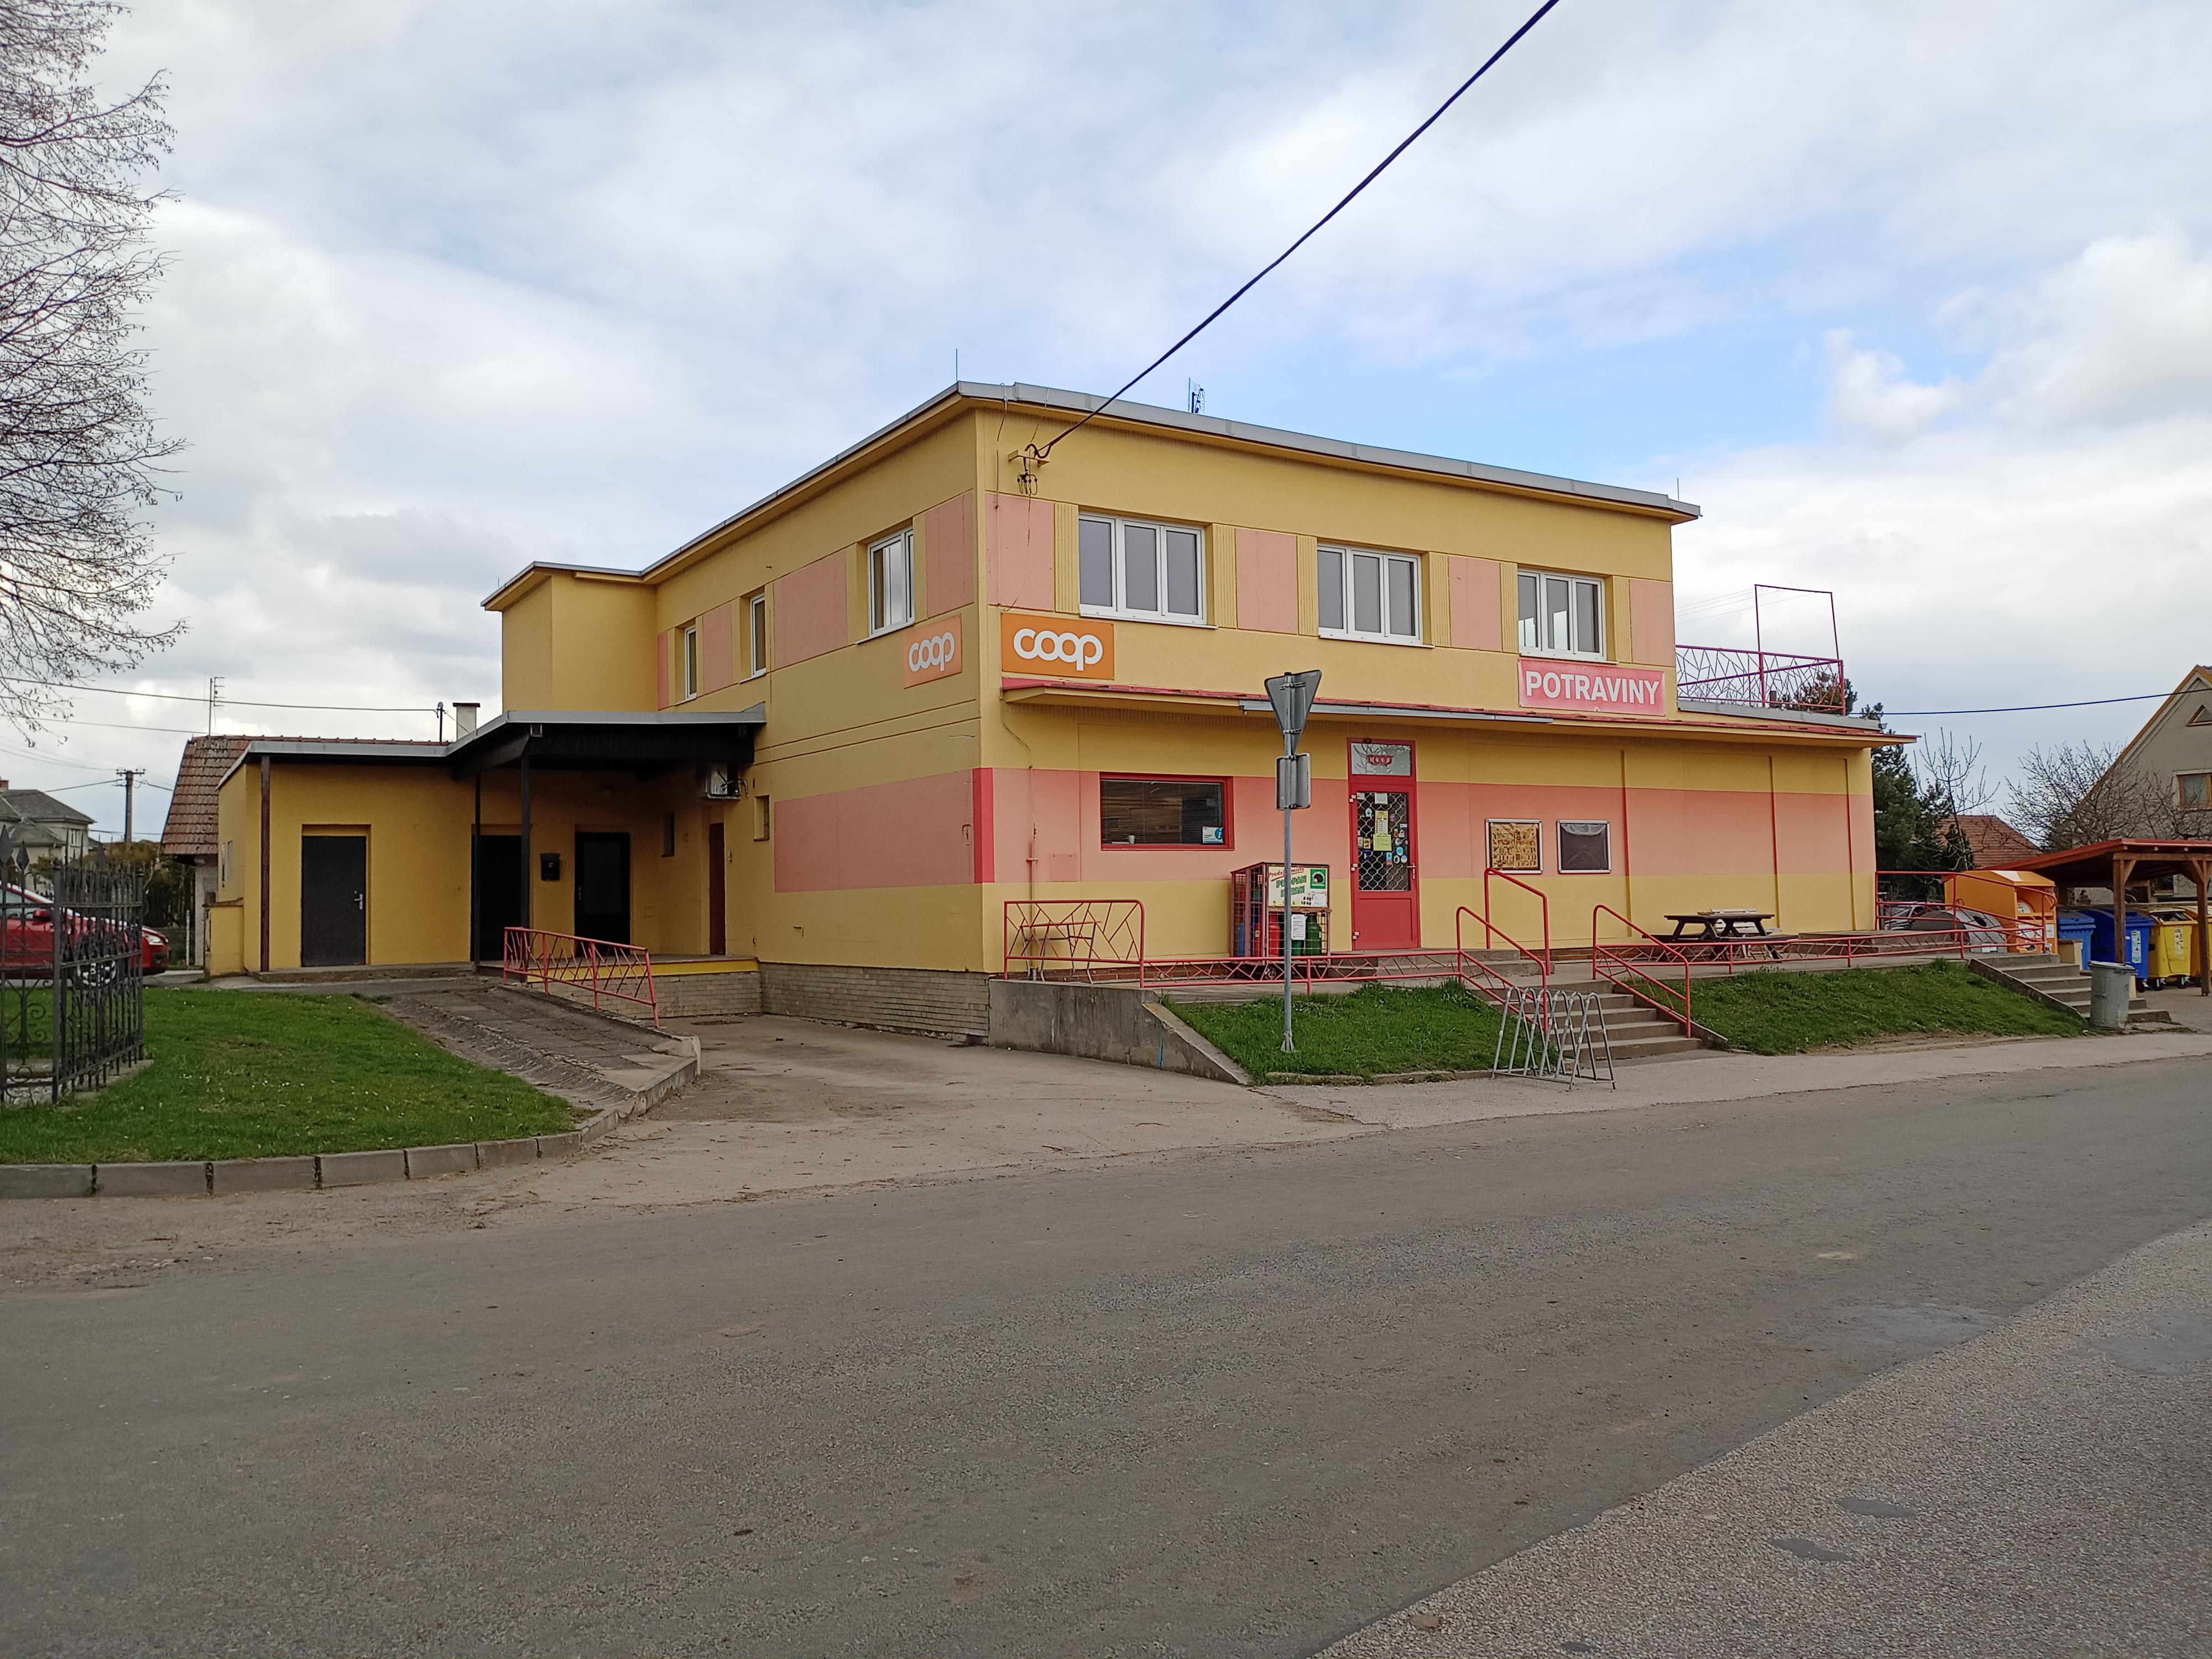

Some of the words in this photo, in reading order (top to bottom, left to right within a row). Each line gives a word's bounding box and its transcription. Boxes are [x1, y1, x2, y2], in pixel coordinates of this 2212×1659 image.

[909, 632, 955, 672] coop
[1014, 628, 1103, 671] coop
[1526, 671, 1660, 705] POTRAVINY
